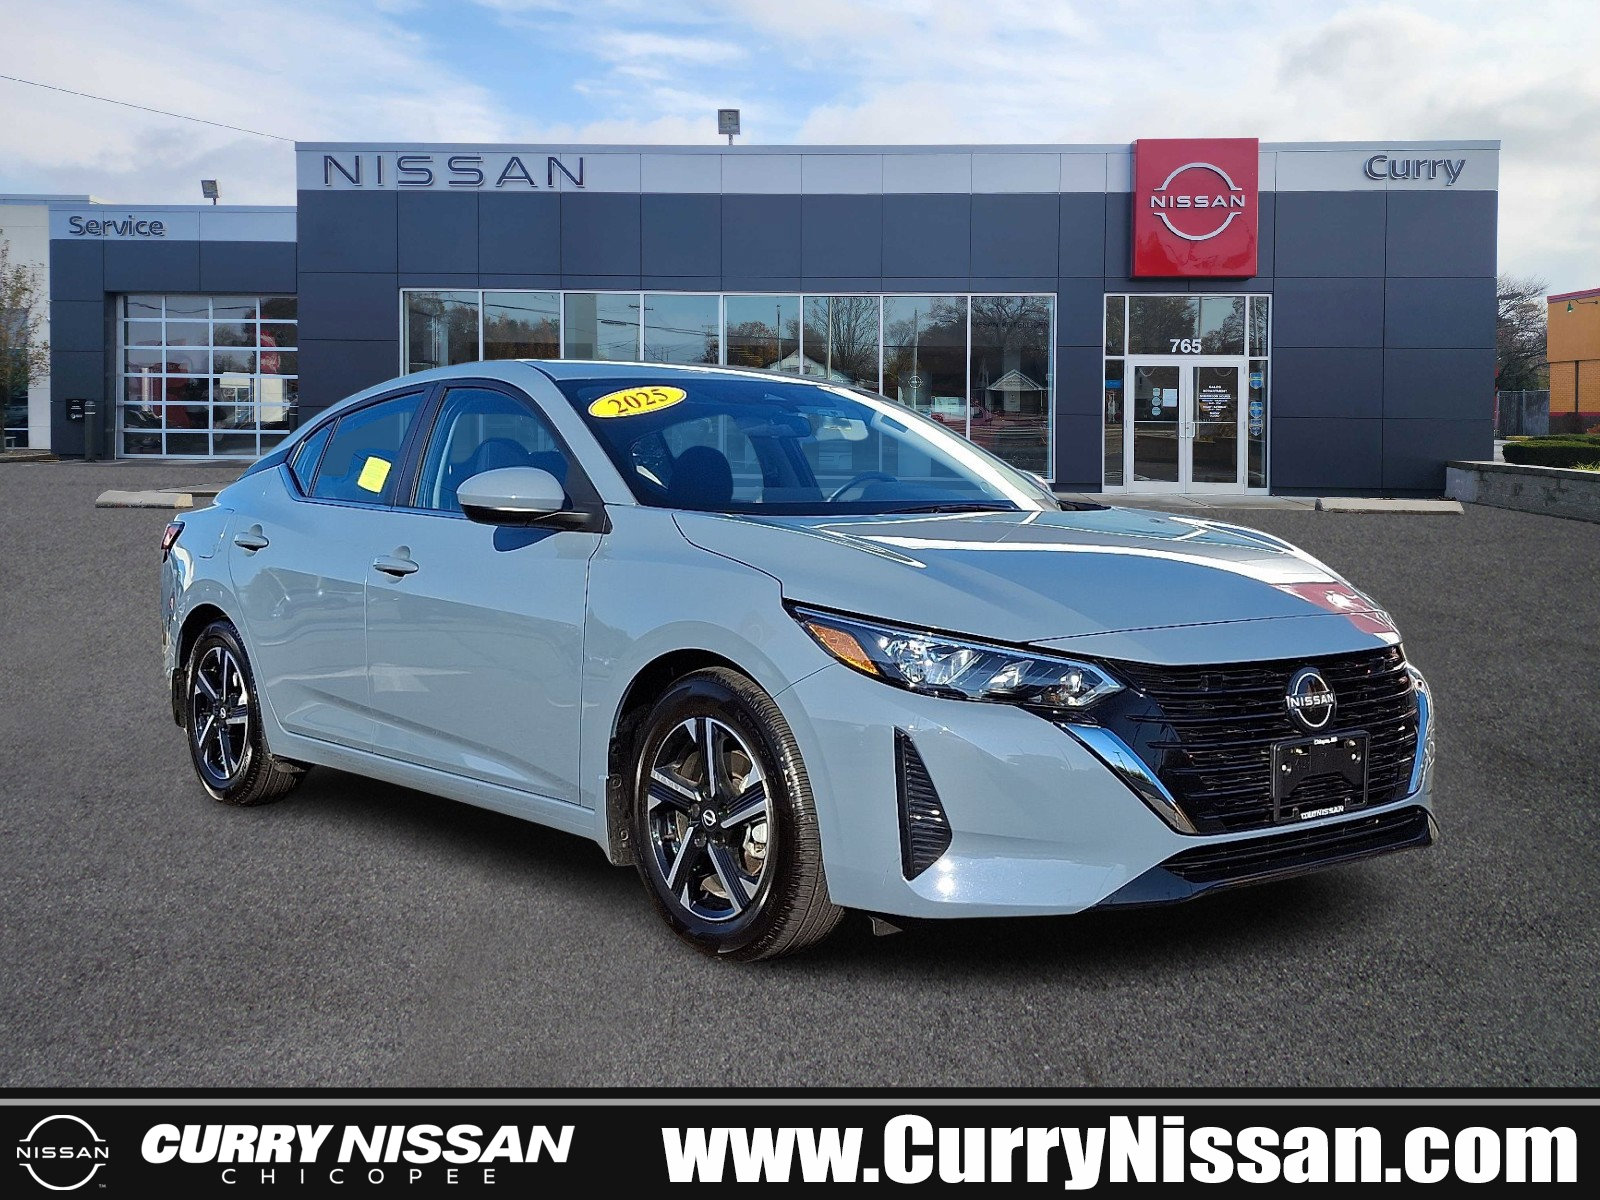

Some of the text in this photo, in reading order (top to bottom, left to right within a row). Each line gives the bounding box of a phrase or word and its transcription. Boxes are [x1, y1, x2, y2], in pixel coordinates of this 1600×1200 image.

[323, 155, 585, 188] NISSAN
[1364, 154, 1466, 186] Curry
[1150, 194, 1246, 209] NISSAN
[68, 214, 165, 236] Service
[1169, 338, 1202, 354] 765
[608, 389, 669, 414] 2025
[1290, 693, 1334, 708] NISSAN
